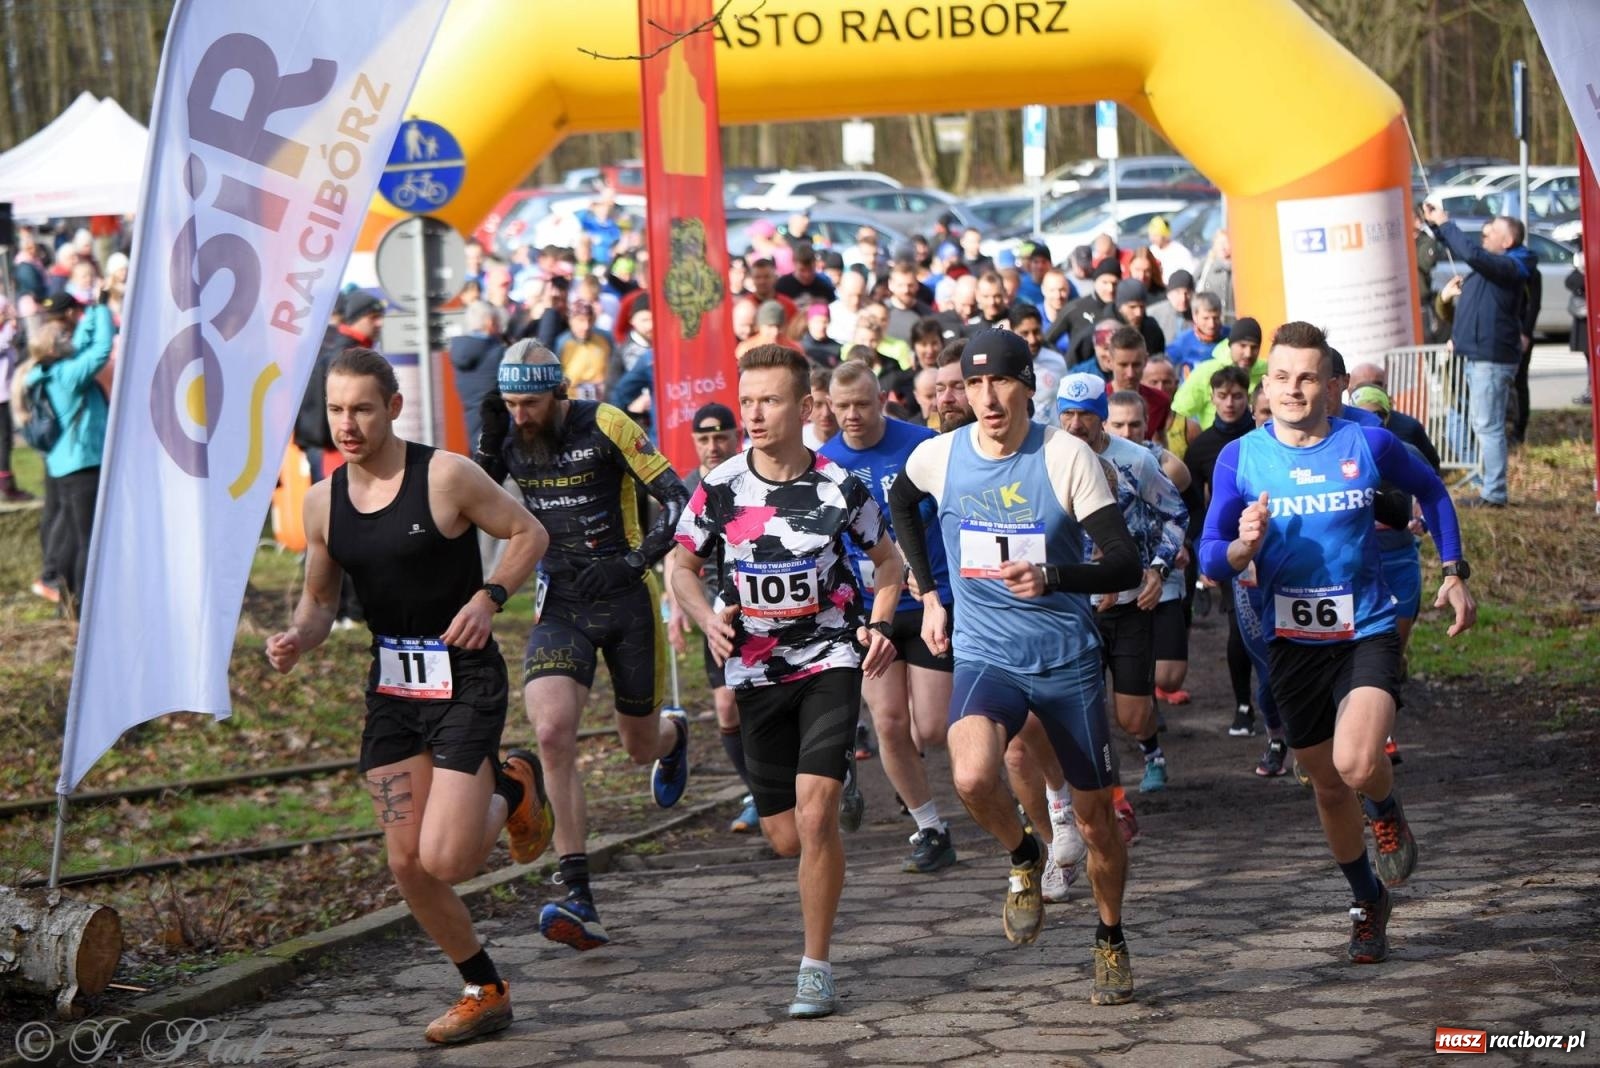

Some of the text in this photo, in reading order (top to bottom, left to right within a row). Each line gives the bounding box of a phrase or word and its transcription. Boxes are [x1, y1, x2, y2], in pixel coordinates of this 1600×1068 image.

[269, 72, 391, 336] RACIBÓRZ
[518, 471, 595, 488] CARBON
[1248, 487, 1375, 519] UNNERS
[768, 559, 807, 569] TWARDZIELA
[996, 536, 1009, 562] 1
[746, 572, 811, 605] 105
[1292, 598, 1338, 628] 66
[398, 652, 427, 684] 11
